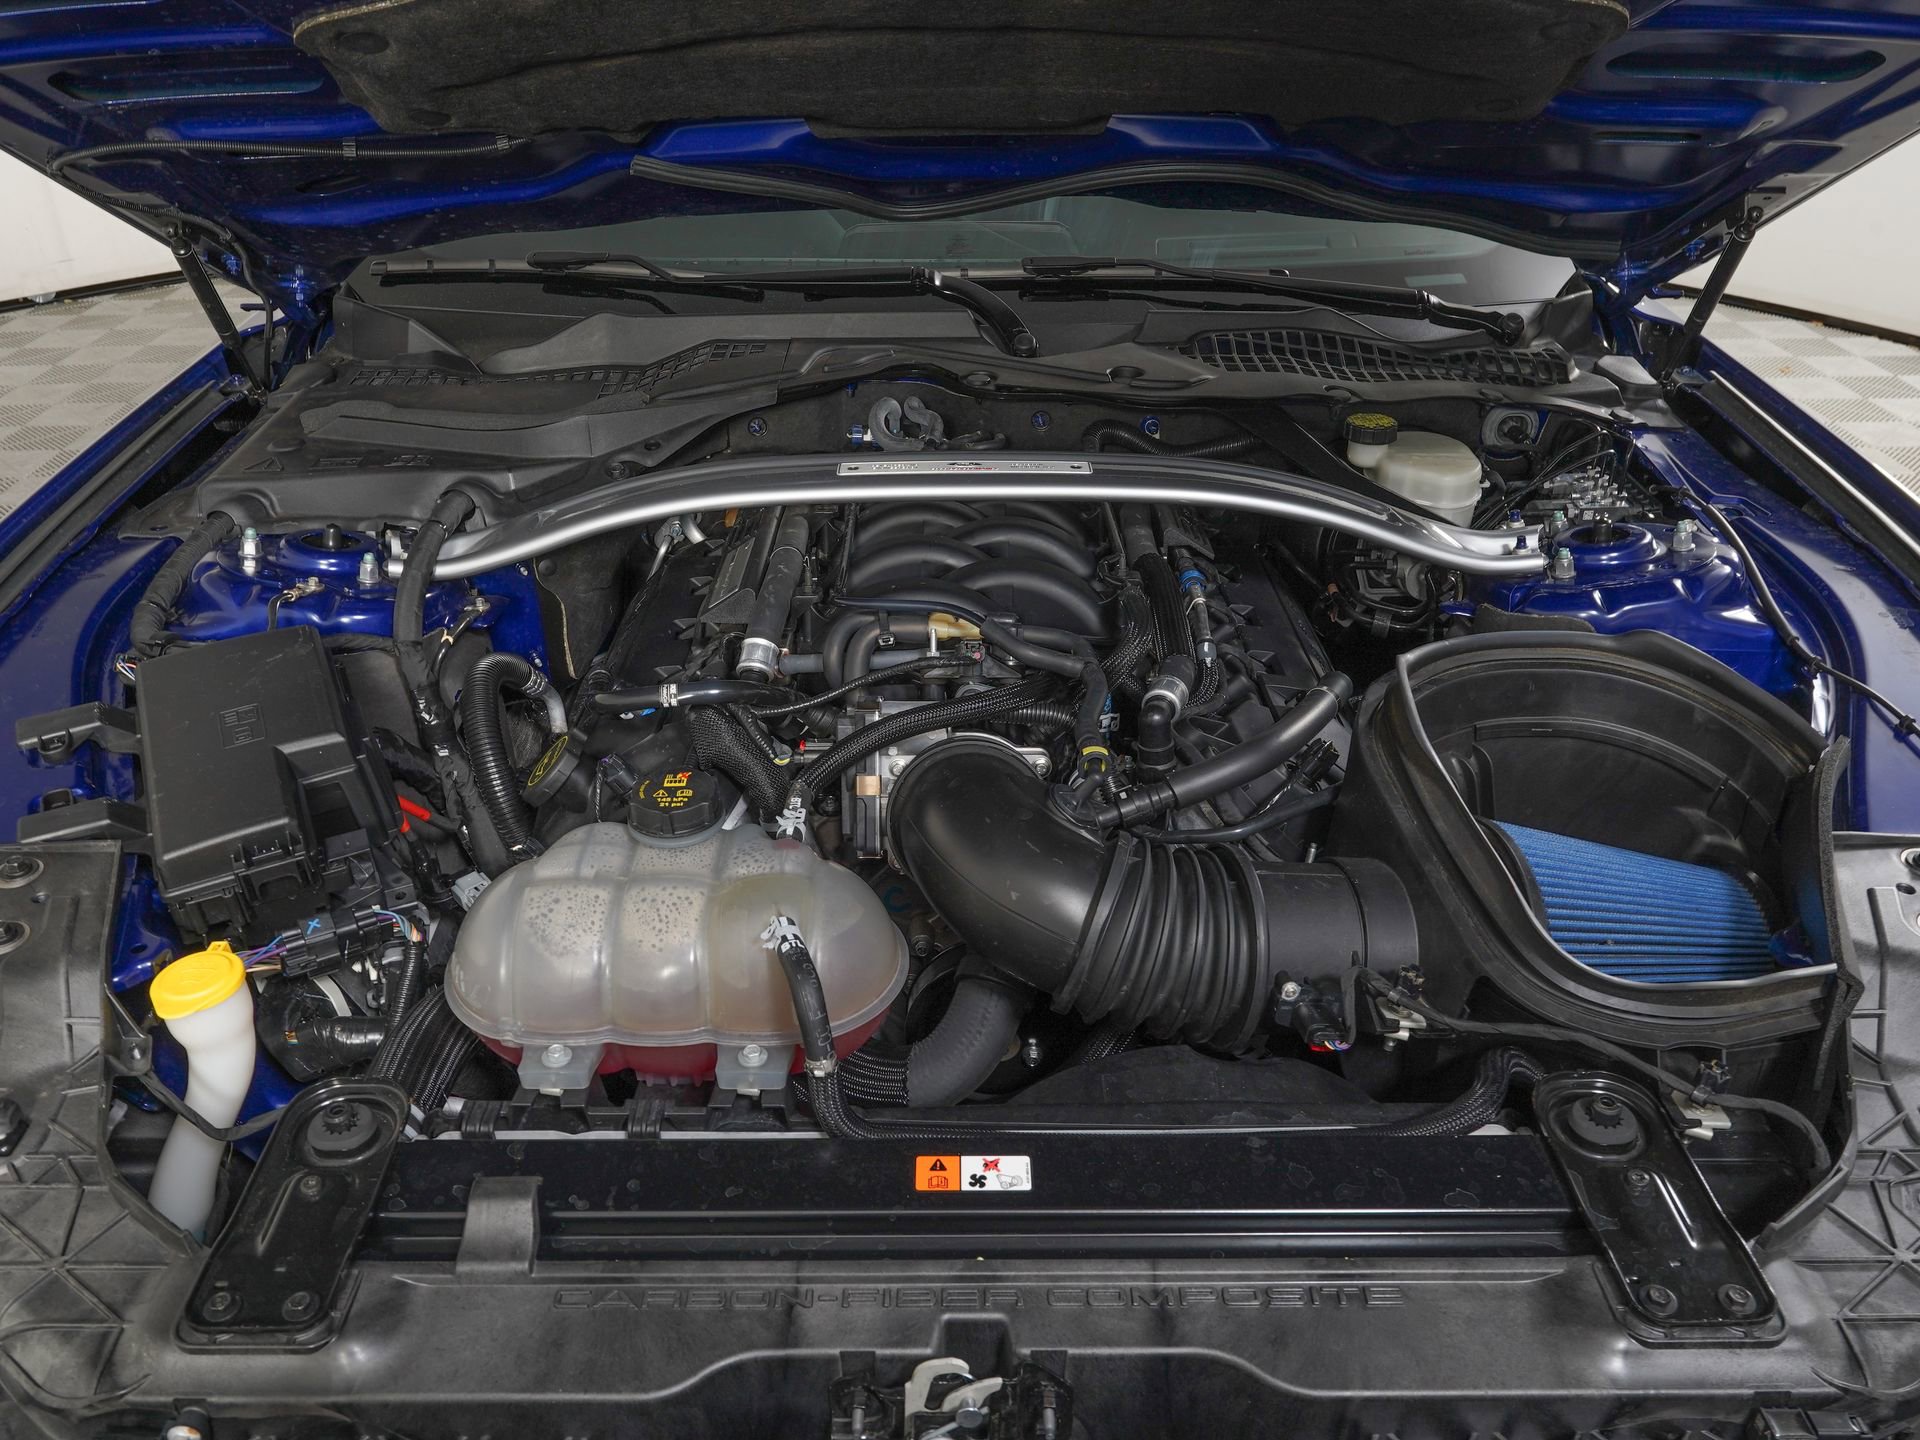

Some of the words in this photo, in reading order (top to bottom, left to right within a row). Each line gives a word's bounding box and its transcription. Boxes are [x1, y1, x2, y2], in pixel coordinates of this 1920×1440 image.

[781, 939, 805, 953] BTL
[552, 1286, 1025, 1311] CARBON-FIBER
[1046, 1285, 1406, 1309] COMPOSITE
